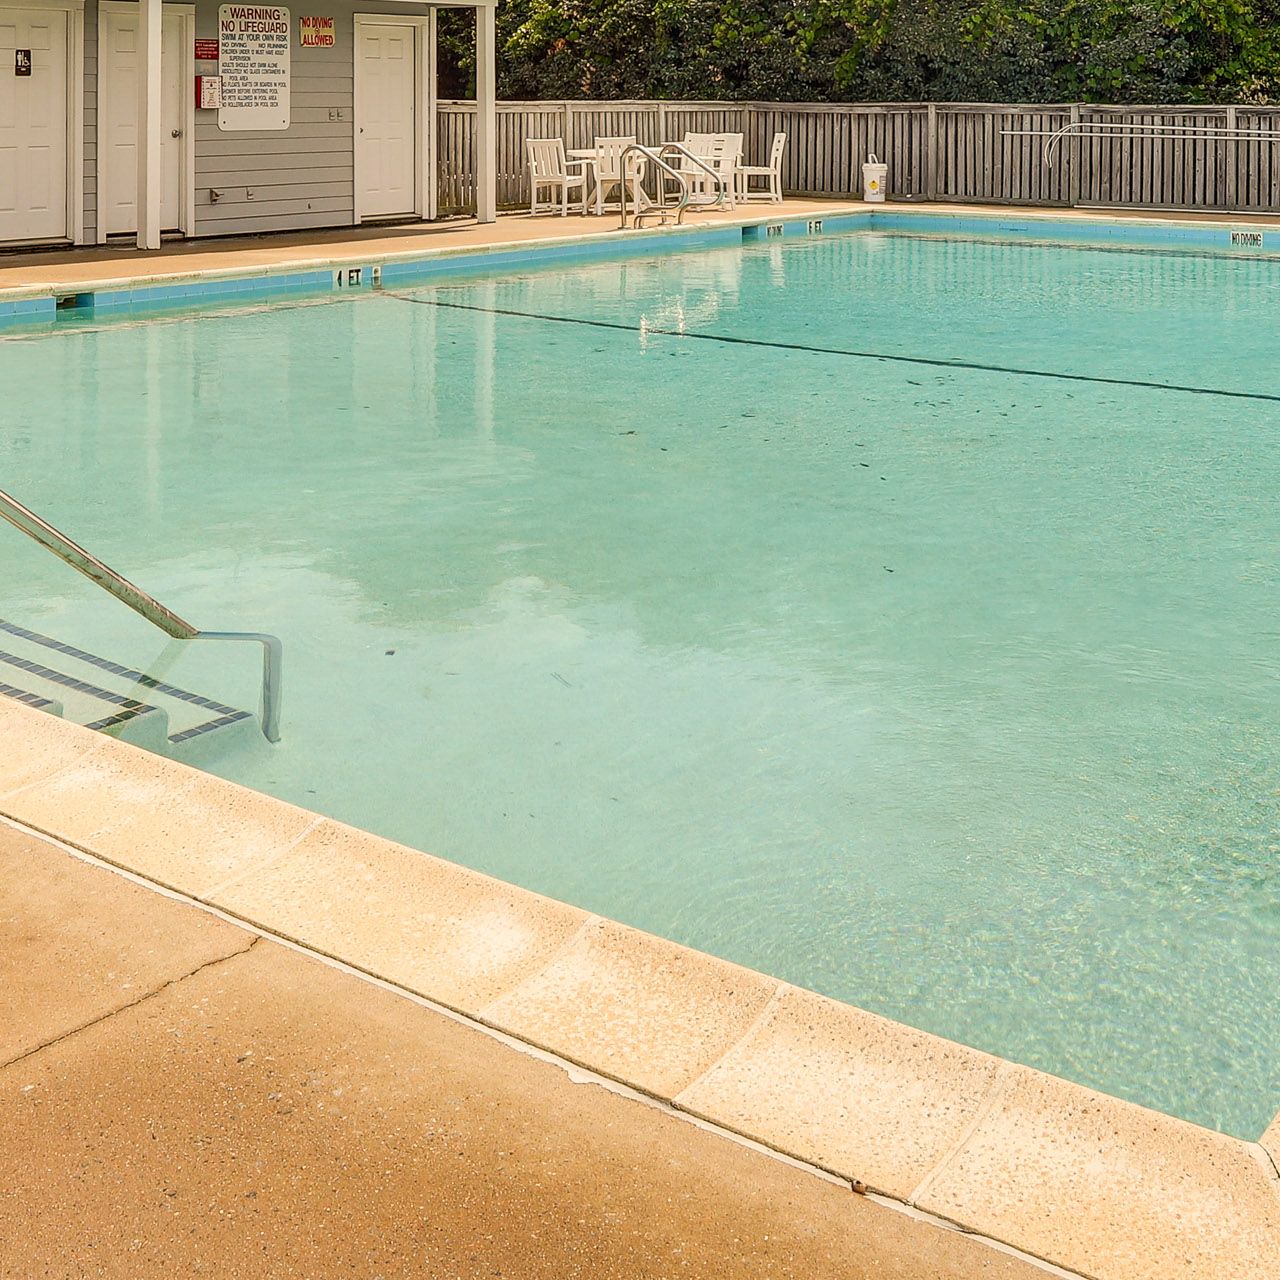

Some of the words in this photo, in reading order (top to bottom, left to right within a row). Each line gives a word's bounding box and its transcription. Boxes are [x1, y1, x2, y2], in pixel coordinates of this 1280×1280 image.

[230, 8, 280, 20] WARNING
[221, 21, 235, 32] NO
[239, 21, 288, 34] LIFEGUARD
[302, 16, 311, 28] NO
[312, 17, 333, 29] DIVING
[221, 33, 236, 41] SWIM
[238, 33, 245, 41] AT
[246, 33, 260, 42] YOUR
[261, 34, 274, 42] OWN
[303, 34, 334, 46] ALLOWED
[1231, 232, 1240, 246] NO
[1240, 233, 1262, 247] DIVING
